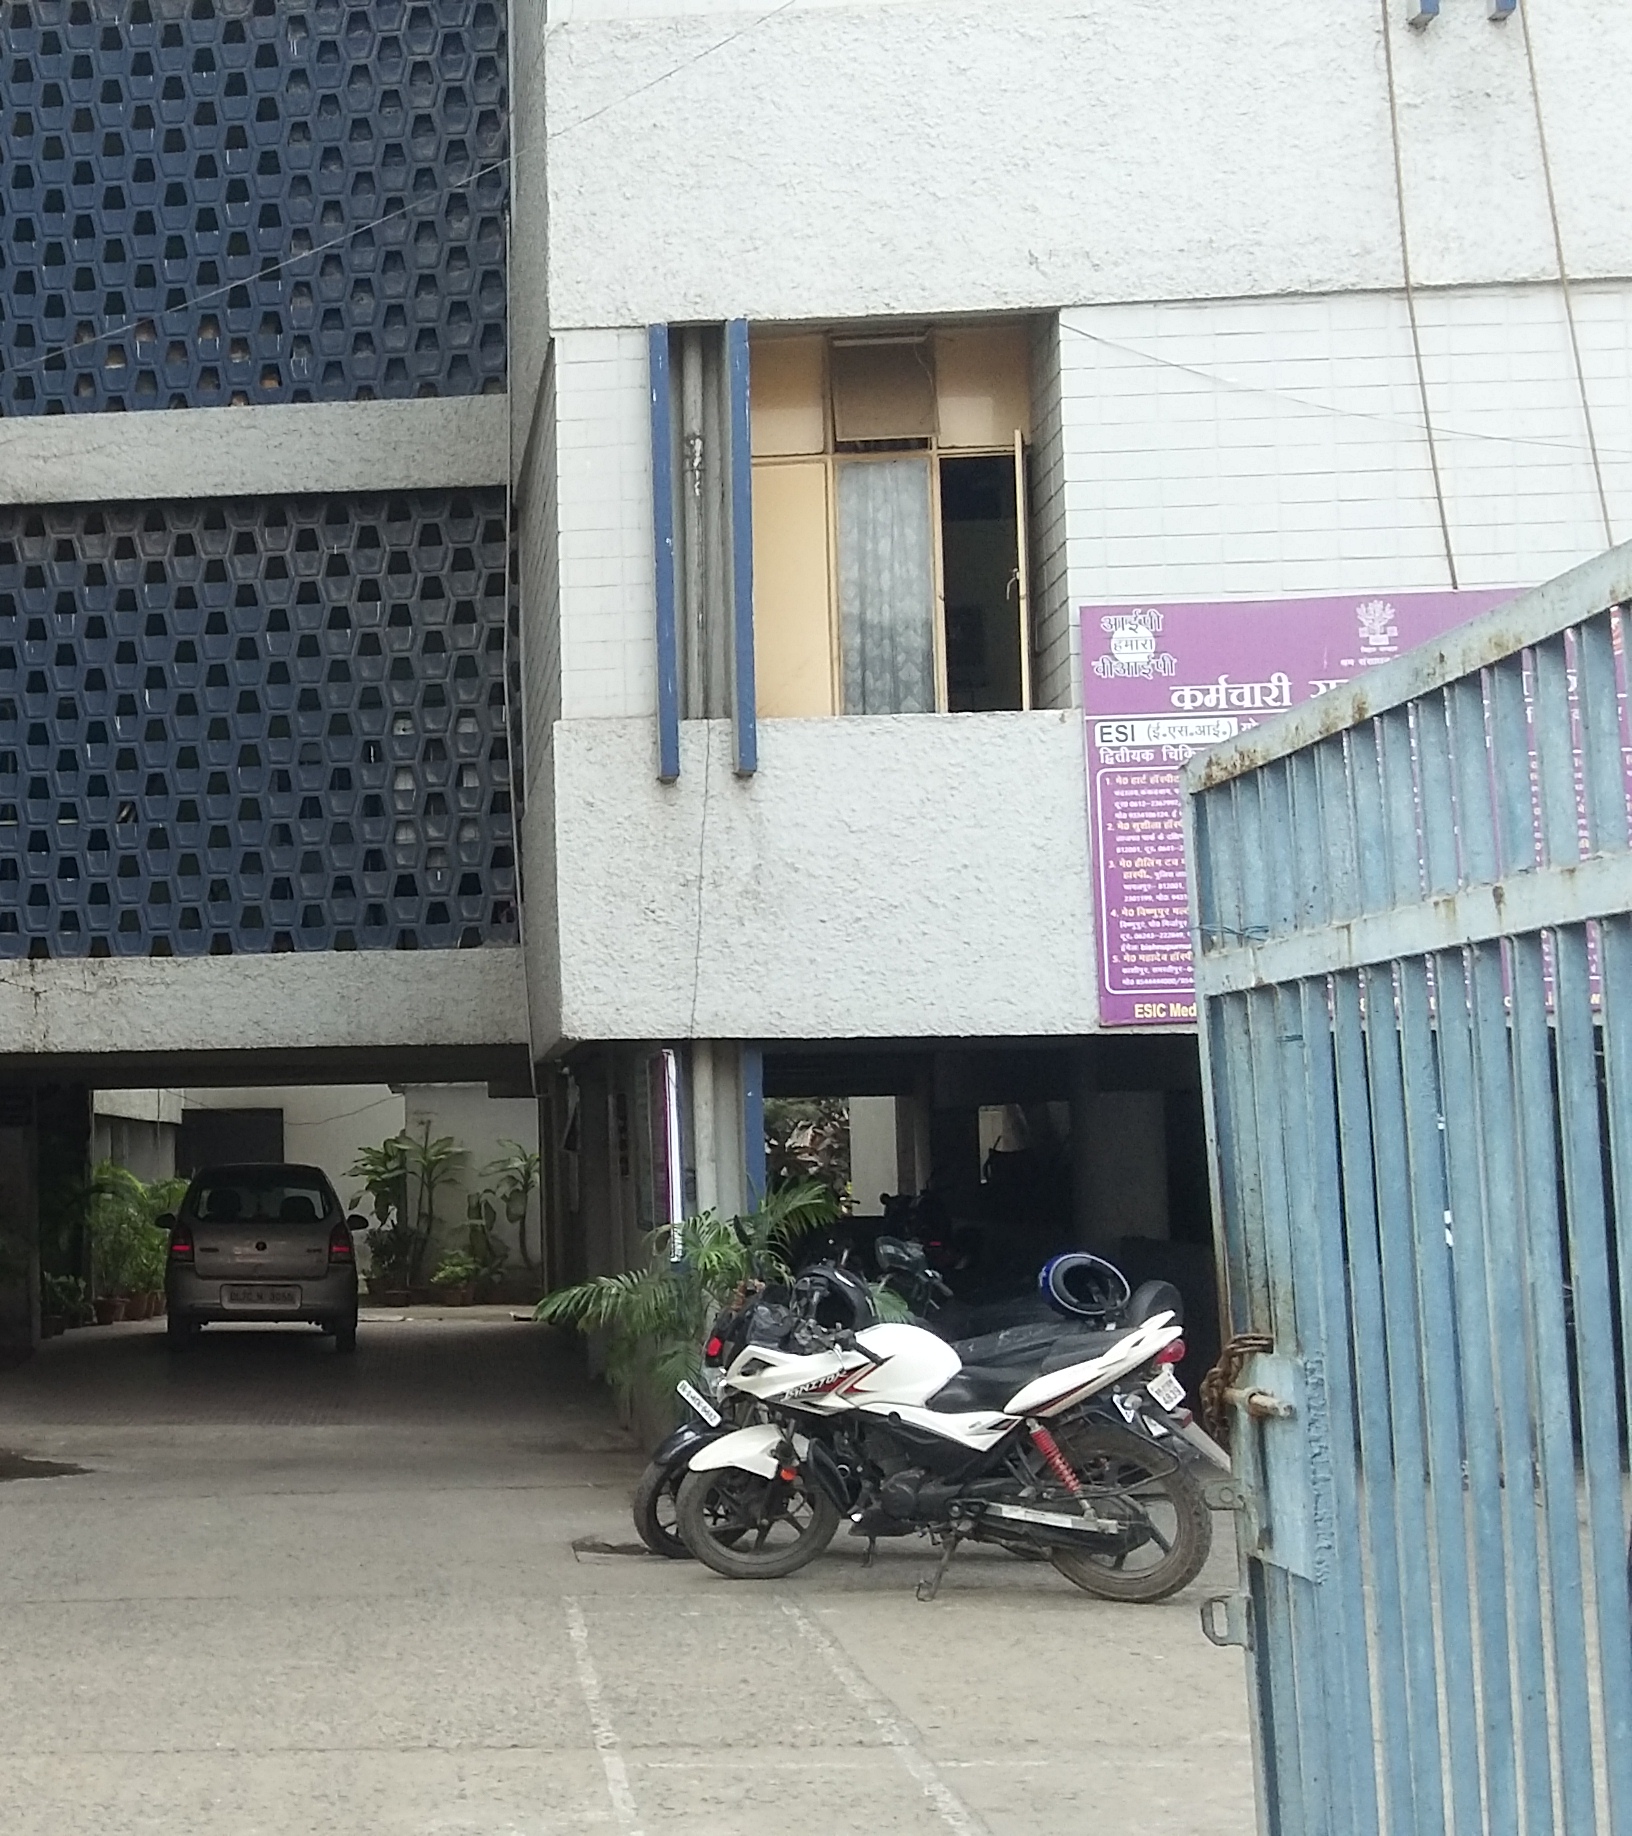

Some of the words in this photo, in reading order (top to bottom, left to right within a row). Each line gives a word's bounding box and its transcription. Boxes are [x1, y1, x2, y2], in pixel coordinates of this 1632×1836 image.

[1113, 638, 1154, 651] हमारा
[1169, 672, 1293, 711] कर्मचारी
[1099, 724, 1135, 742] ESI
[1099, 746, 1155, 764] द्वितीयक
[1134, 1003, 1166, 1018] ESIC
[1169, 1002, 1197, 1016] Med
